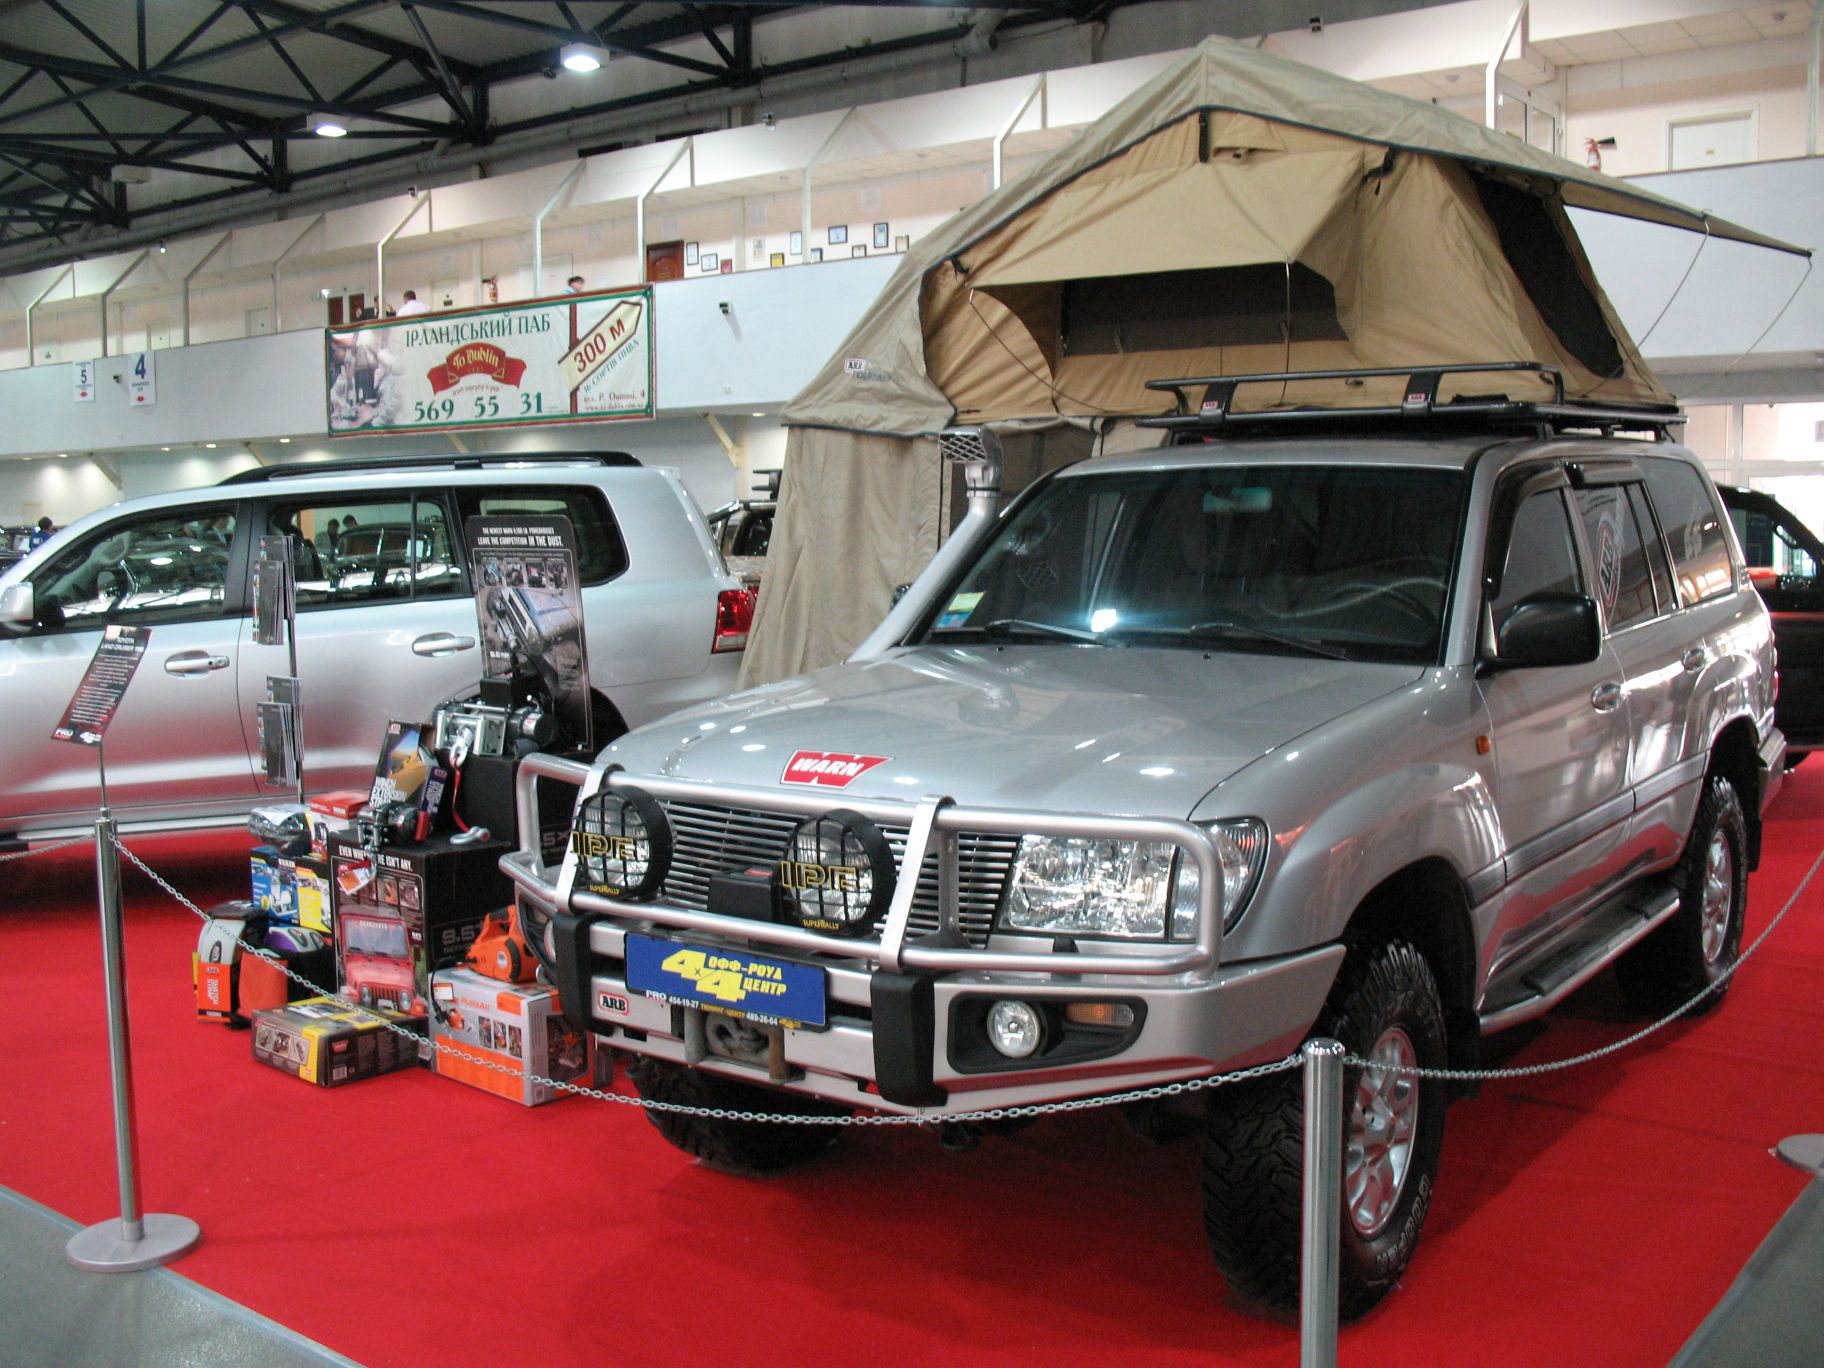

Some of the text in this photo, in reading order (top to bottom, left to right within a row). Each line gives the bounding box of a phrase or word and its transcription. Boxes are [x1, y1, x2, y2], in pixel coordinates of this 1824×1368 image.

[406, 312, 551, 347] ІРЛАНДСЬКИЙ ПАБ
[453, 347, 499, 369] To Dublin
[574, 333, 606, 373] 300
[81, 369, 87, 384] 5
[135, 354, 147, 379] 4
[414, 398, 454, 422] 569
[474, 395, 499, 418] 55
[520, 391, 543, 415] 31
[477, 536, 491, 546] LEAVE
[491, 536, 499, 546] THE
[528, 535, 536, 547] IN
[536, 535, 547, 547] THE
[791, 757, 865, 777] WARN
[339, 845, 352, 858] EVEN
[780, 860, 858, 892] IPF
[708, 955, 783, 981] ОФФ-РОУД
[645, 989, 668, 1002] PRO
[743, 976, 788, 997] ЦЕНТР
[602, 994, 627, 1012] ARB
